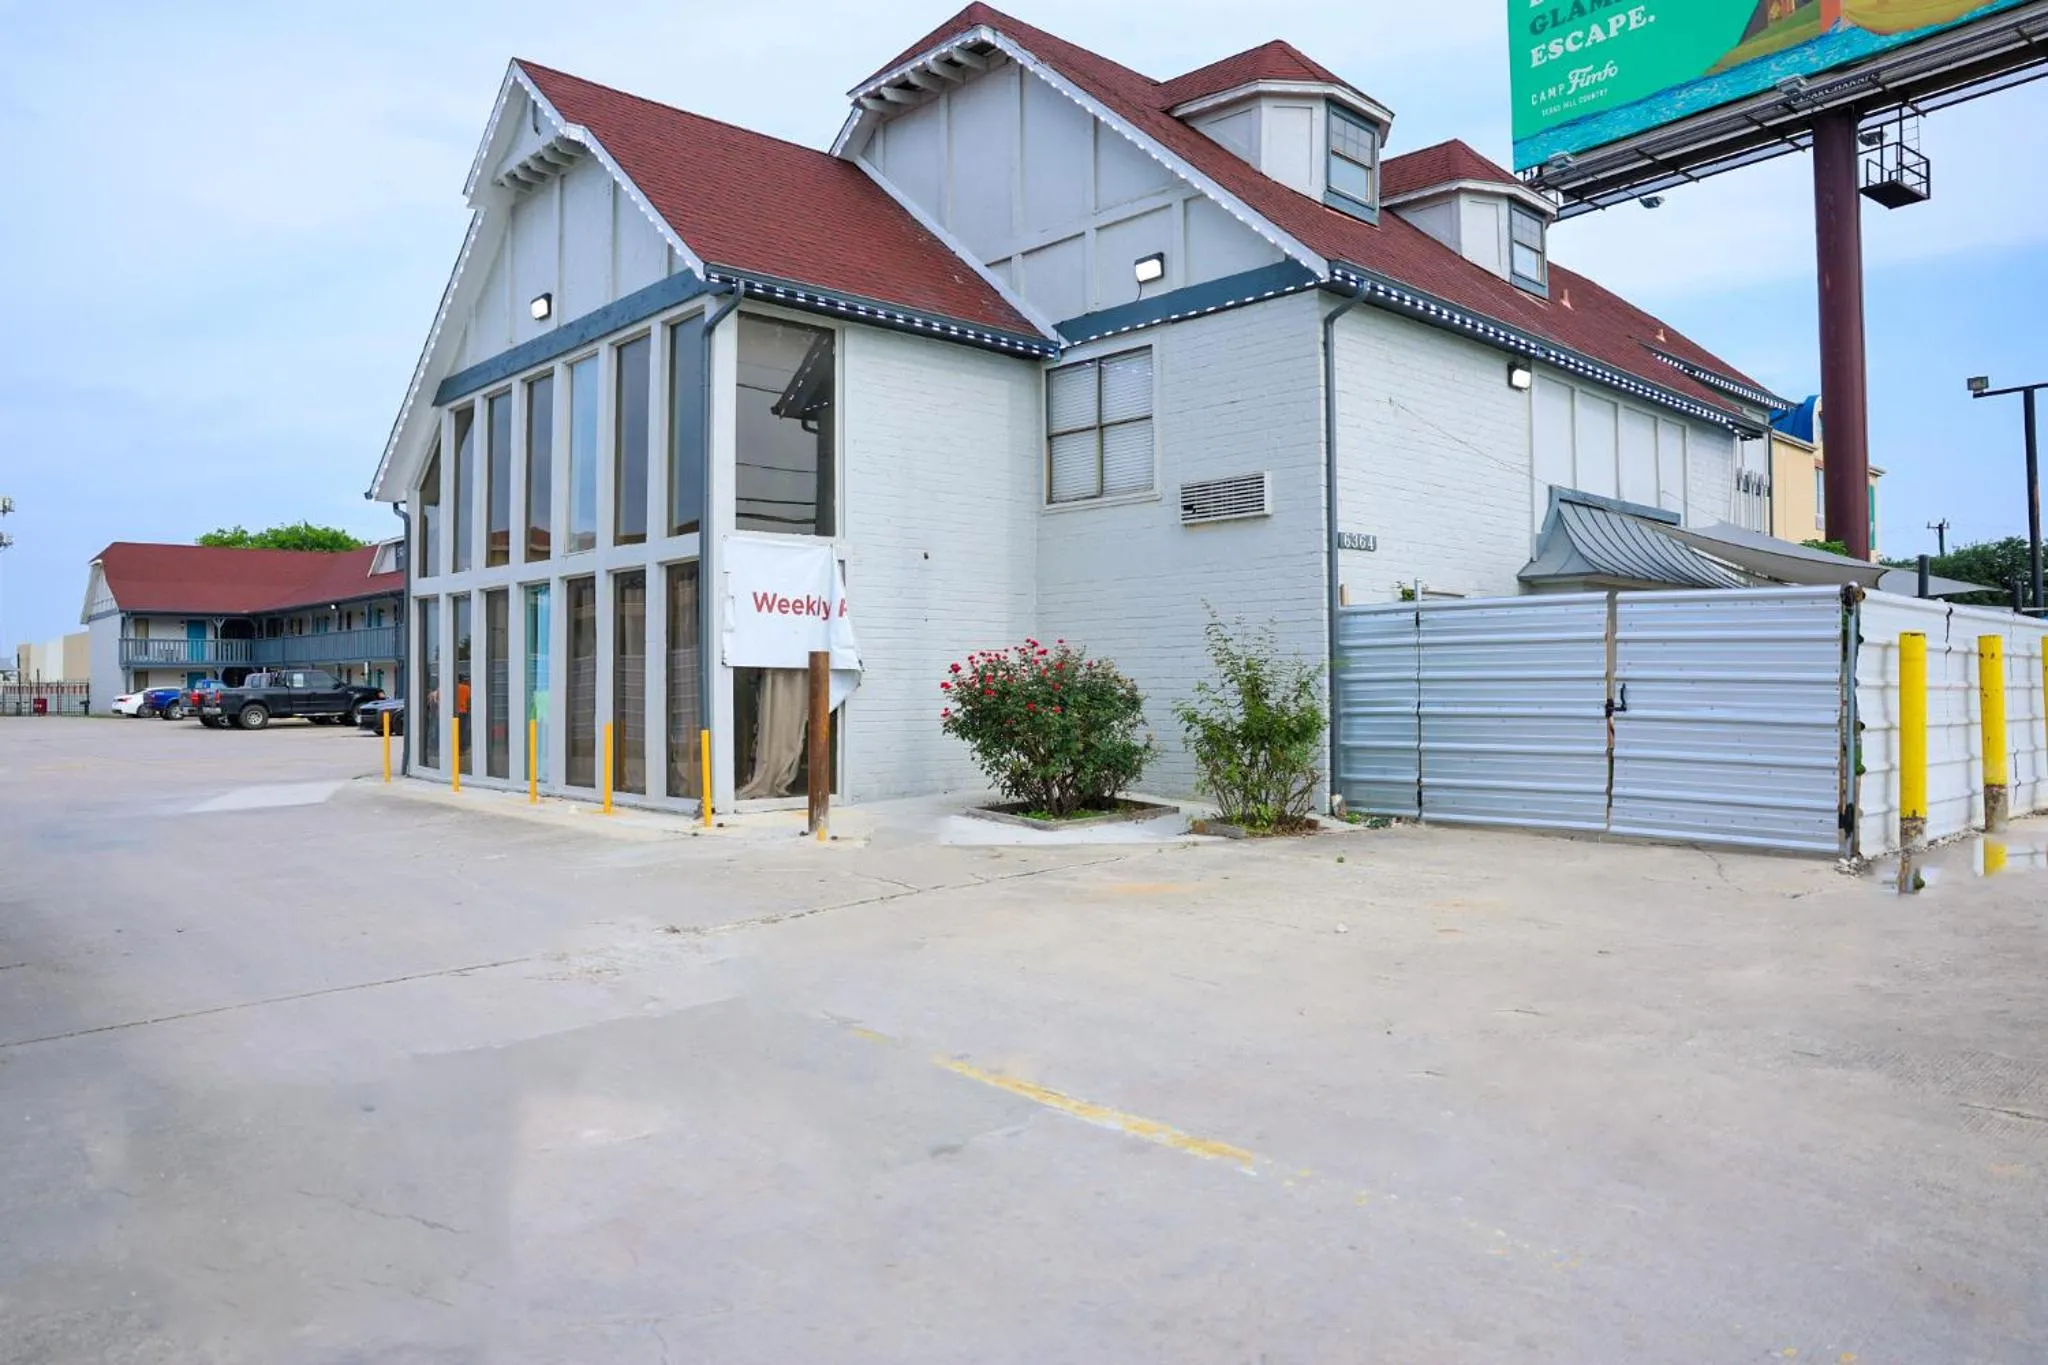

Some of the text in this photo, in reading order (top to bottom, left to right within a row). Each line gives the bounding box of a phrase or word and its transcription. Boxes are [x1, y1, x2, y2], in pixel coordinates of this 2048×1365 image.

[1530, 6, 1656, 68] ESCAPE.
[1531, 83, 1565, 106] CAMP
[1344, 533, 1375, 550] 6364
[752, 591, 832, 621] Weekly
